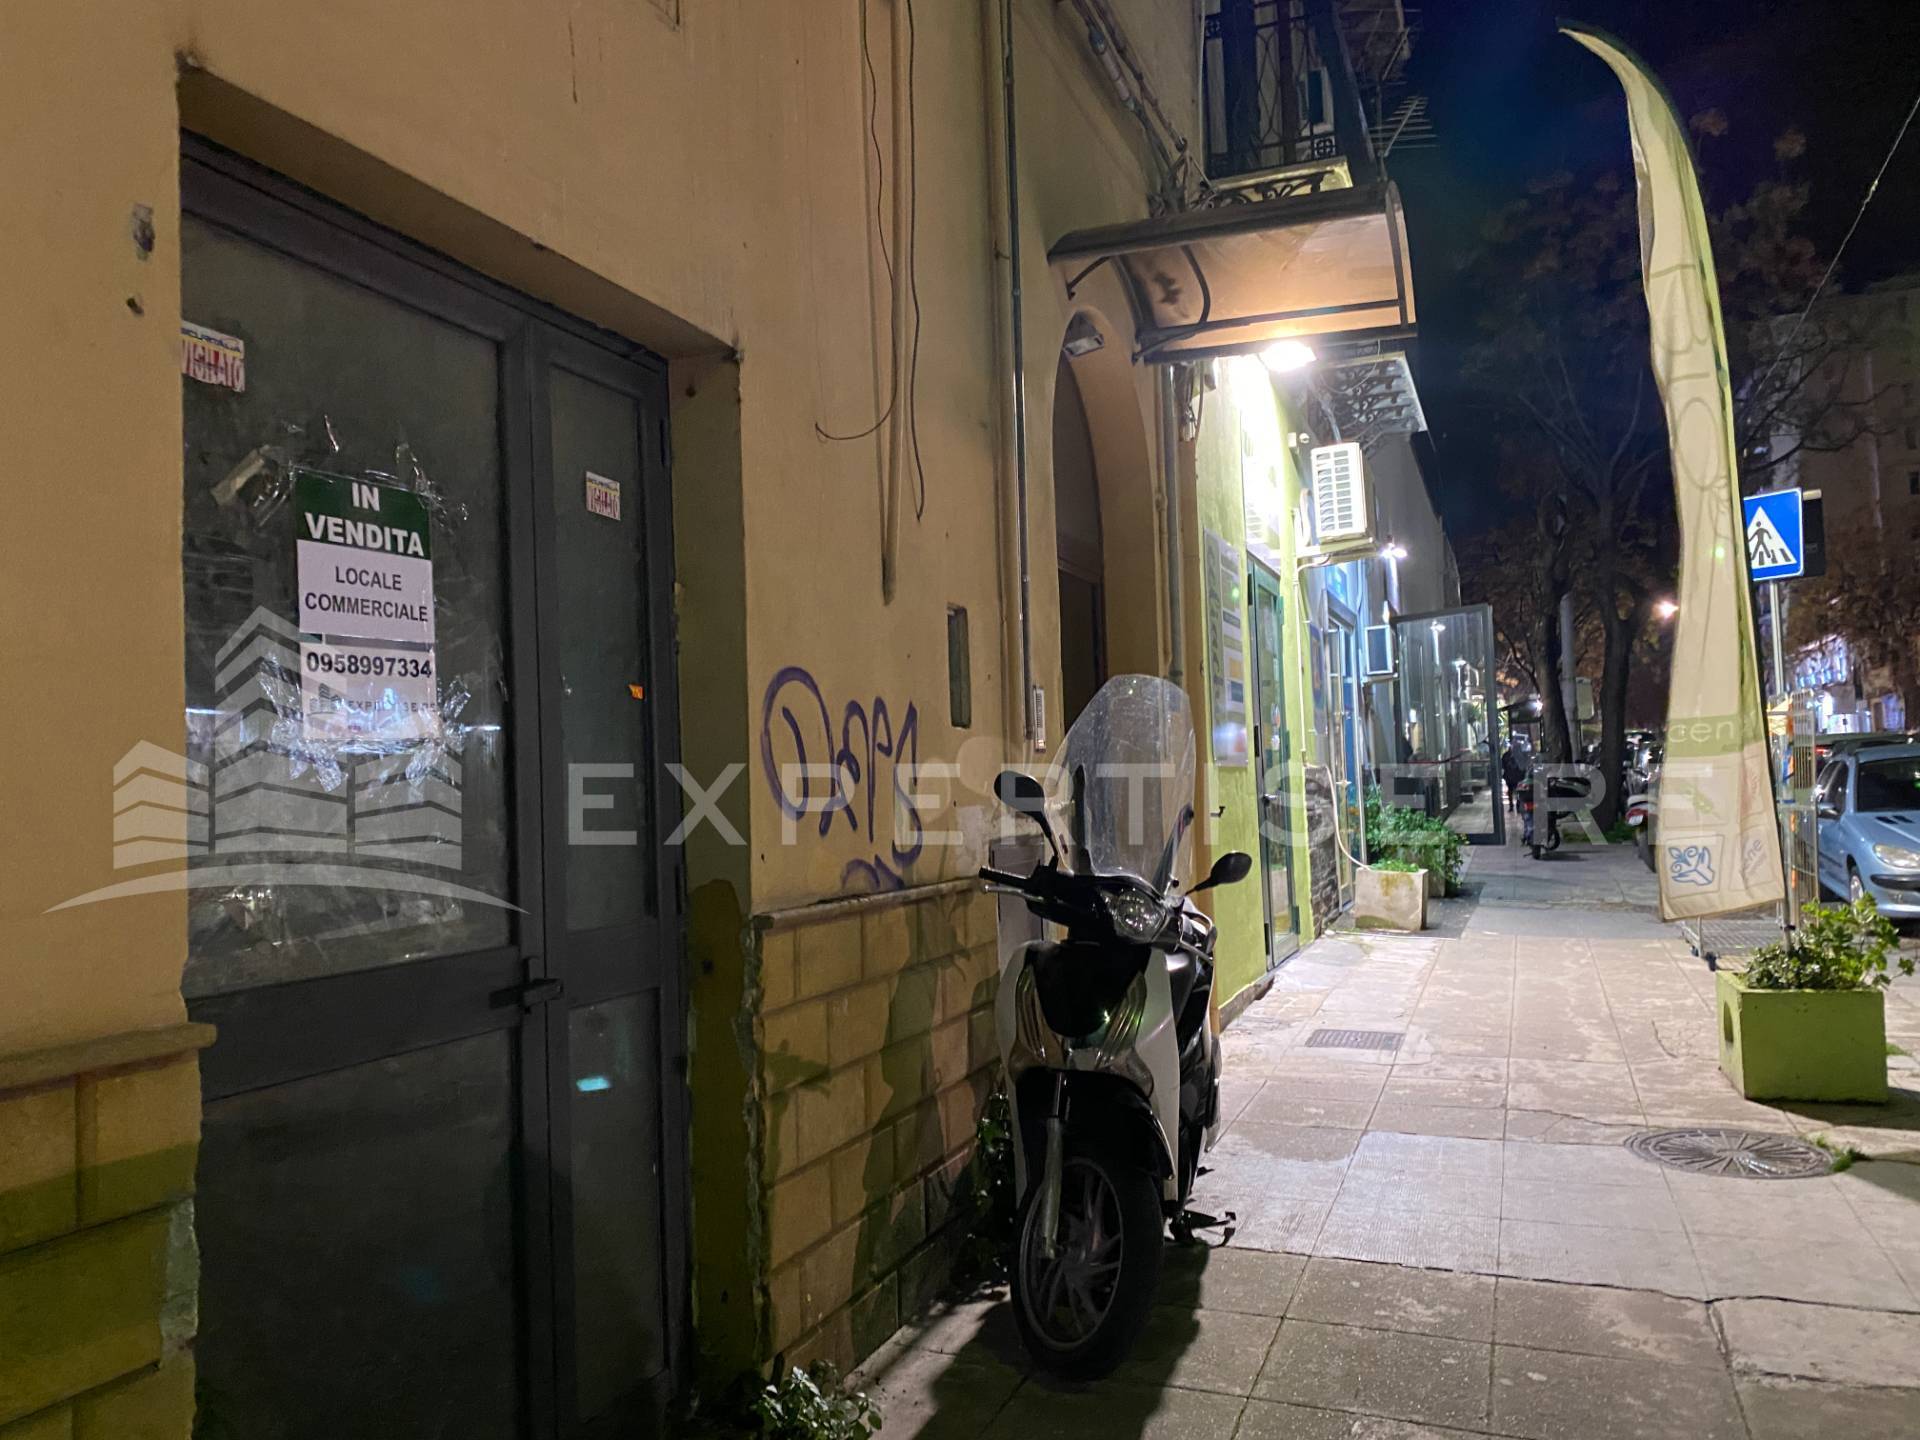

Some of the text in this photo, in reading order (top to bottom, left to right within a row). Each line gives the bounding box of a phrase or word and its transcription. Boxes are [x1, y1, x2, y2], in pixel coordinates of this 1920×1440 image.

[351, 482, 380, 512] IN
[304, 512, 424, 556] VENDITA
[335, 566, 402, 591] LOCALE
[305, 592, 429, 622] COMMERCIALE
[306, 651, 432, 678] 0958997334
